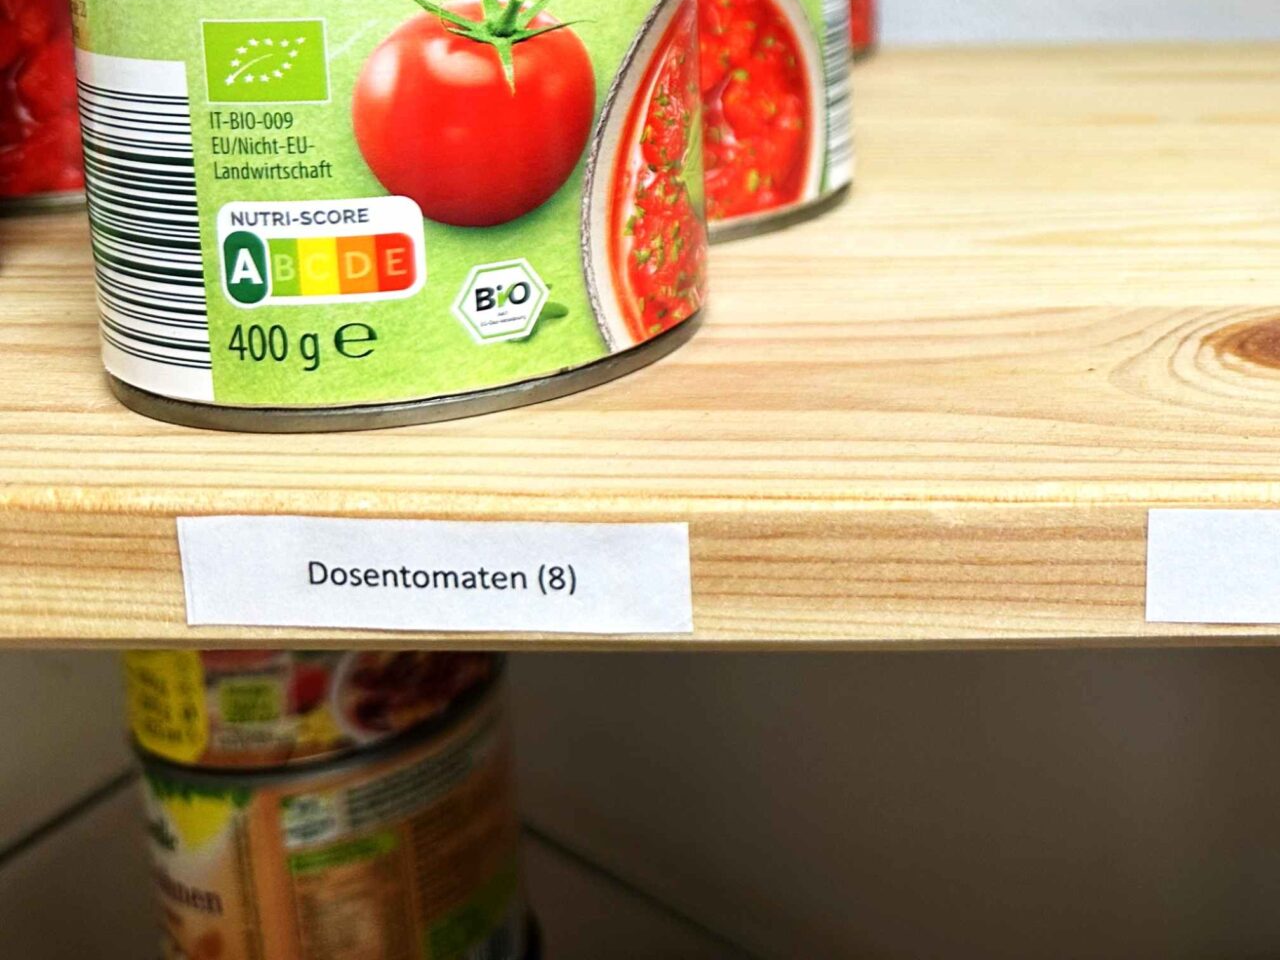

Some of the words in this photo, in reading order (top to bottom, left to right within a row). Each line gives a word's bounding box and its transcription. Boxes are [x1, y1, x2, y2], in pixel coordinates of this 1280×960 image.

[209, 111, 294, 130] IT-BIO-009
[211, 136, 316, 155] EU/Nicht-EU-
[214, 160, 333, 180] Landwirtschaft
[231, 208, 370, 227] NUTRI-SCORE
[230, 248, 264, 284] A
[273, 254, 296, 281] B
[304, 252, 330, 281] C
[344, 251, 372, 279] D
[385, 248, 407, 276] E
[228, 323, 288, 361] 400
[300, 332, 320, 371] g
[308, 560, 527, 590] Dosentomaten
[538, 564, 576, 595] (8)
